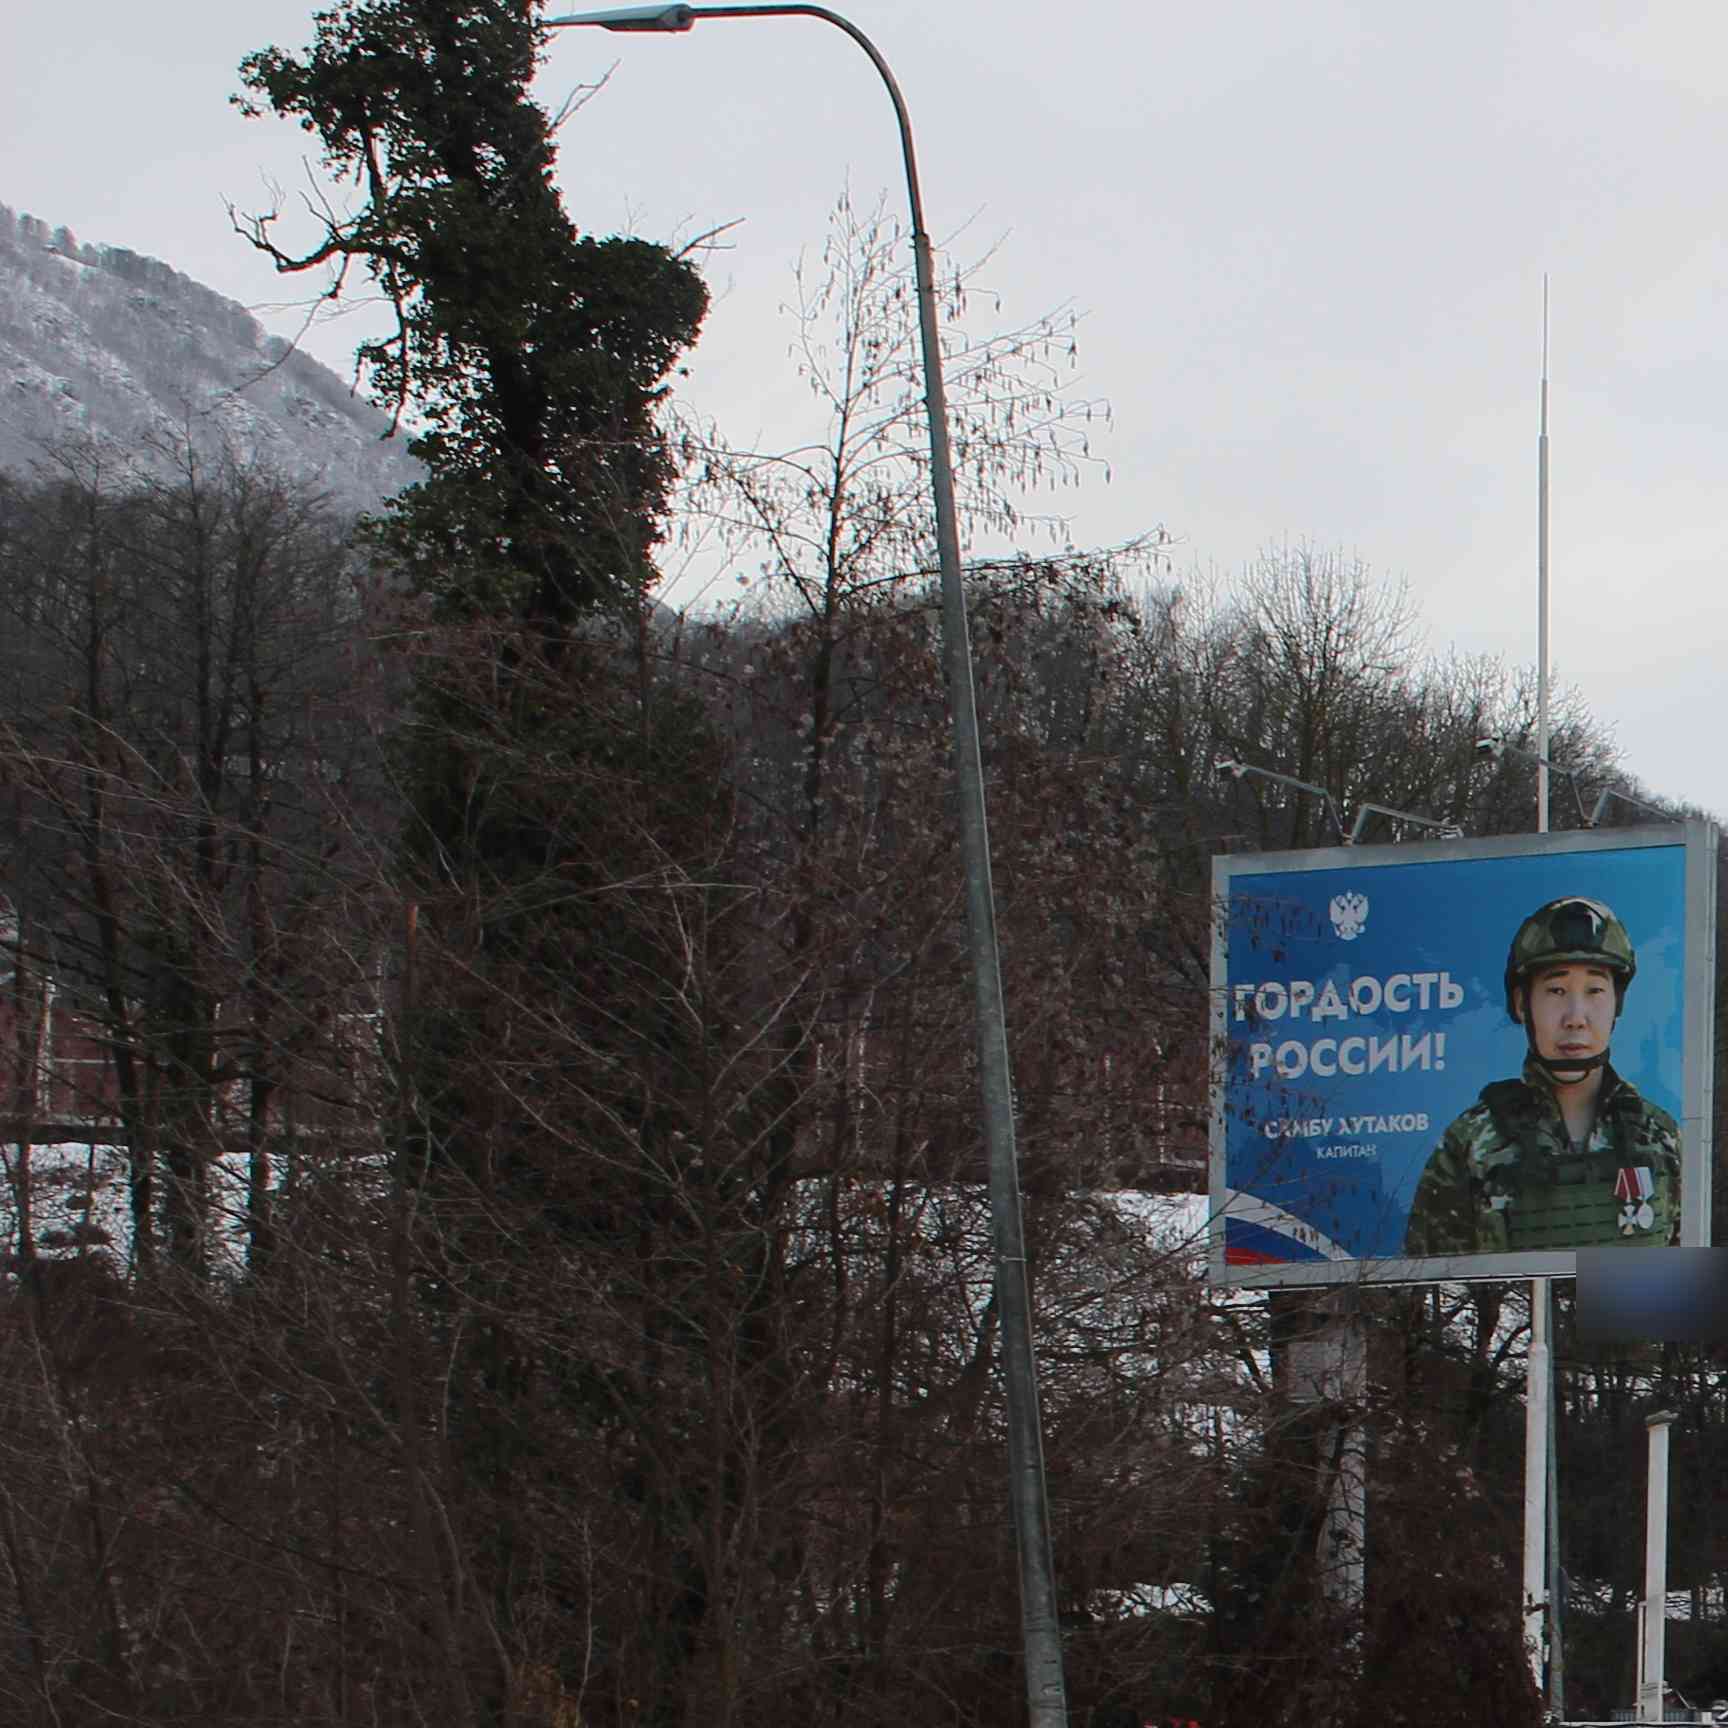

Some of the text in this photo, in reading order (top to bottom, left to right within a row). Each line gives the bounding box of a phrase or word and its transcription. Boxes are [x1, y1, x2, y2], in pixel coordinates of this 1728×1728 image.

[1234, 972, 1465, 1022] ГОРДОСТЬ
[1250, 1032, 1446, 1081] РОССИИ!
[1338, 1113, 1430, 1137] ХУТАКОВ
[1316, 1144, 1377, 1160] КАПИТАН
